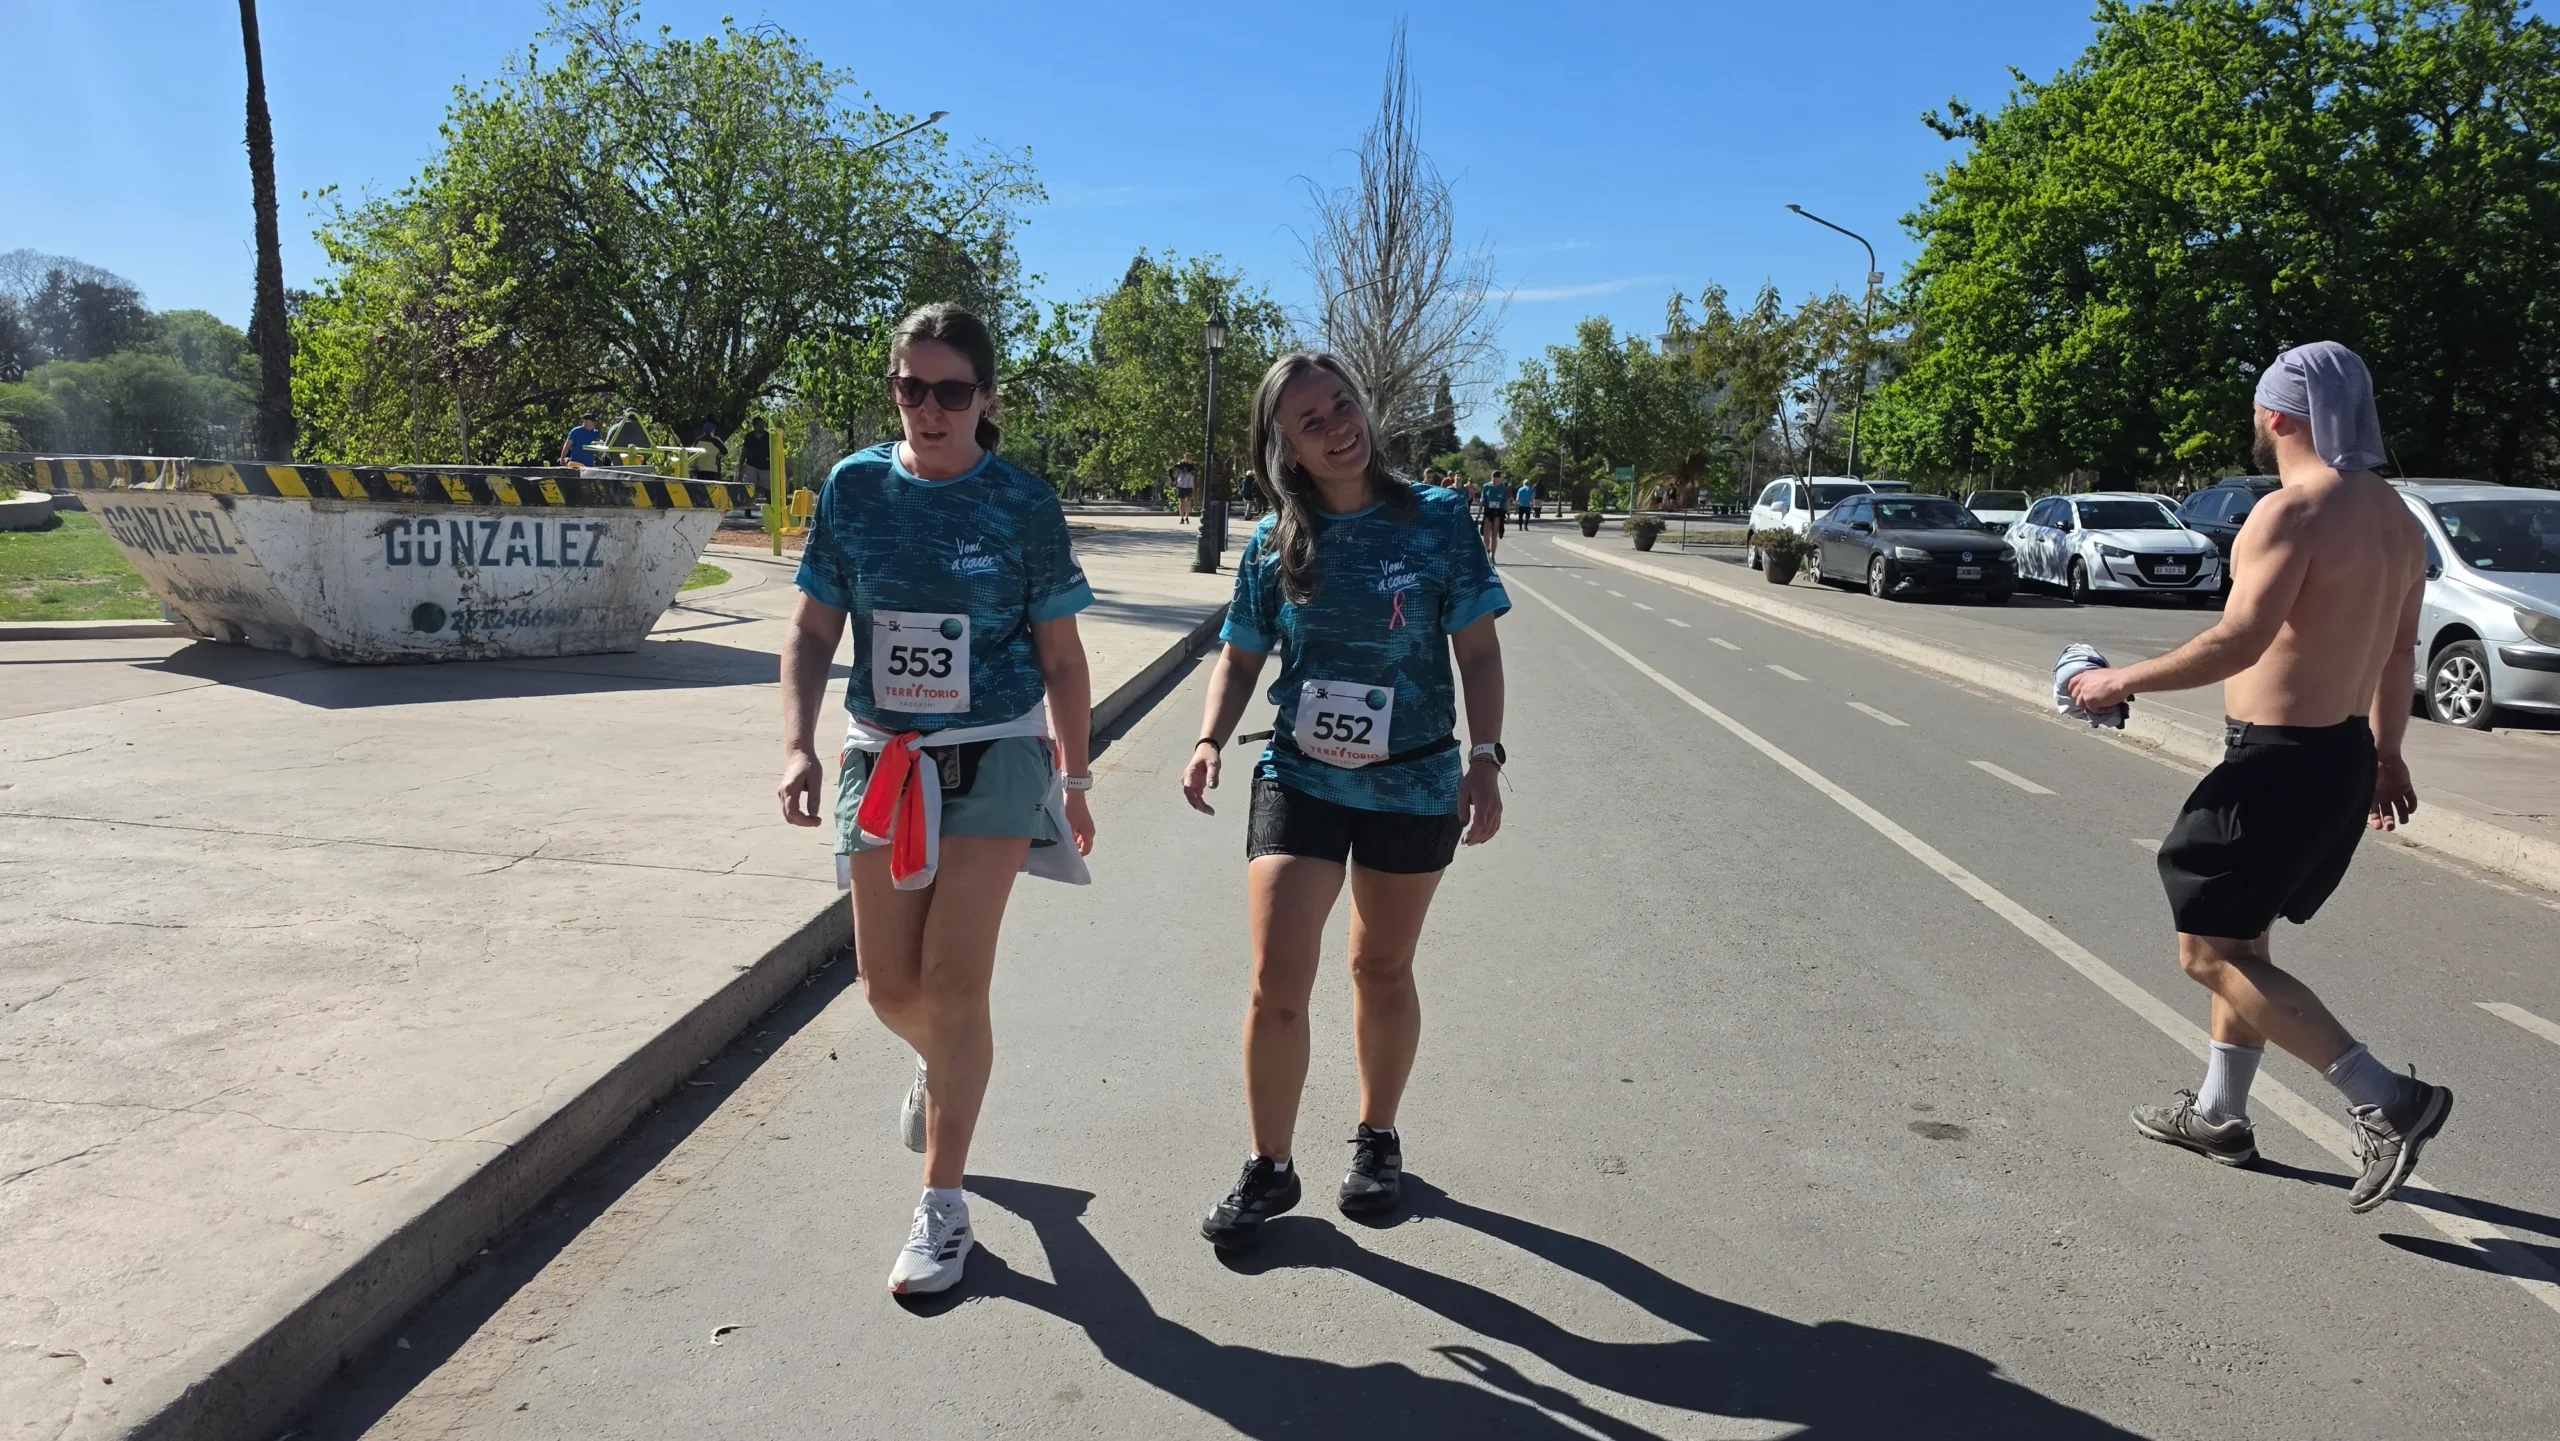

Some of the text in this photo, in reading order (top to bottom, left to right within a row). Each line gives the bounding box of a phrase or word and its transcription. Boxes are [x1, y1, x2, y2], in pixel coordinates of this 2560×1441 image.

[102, 506, 238, 555] GONZALEZ
[385, 518, 605, 568] GONZALEZ
[888, 645, 953, 678] 553
[1312, 712, 1373, 745] 552
